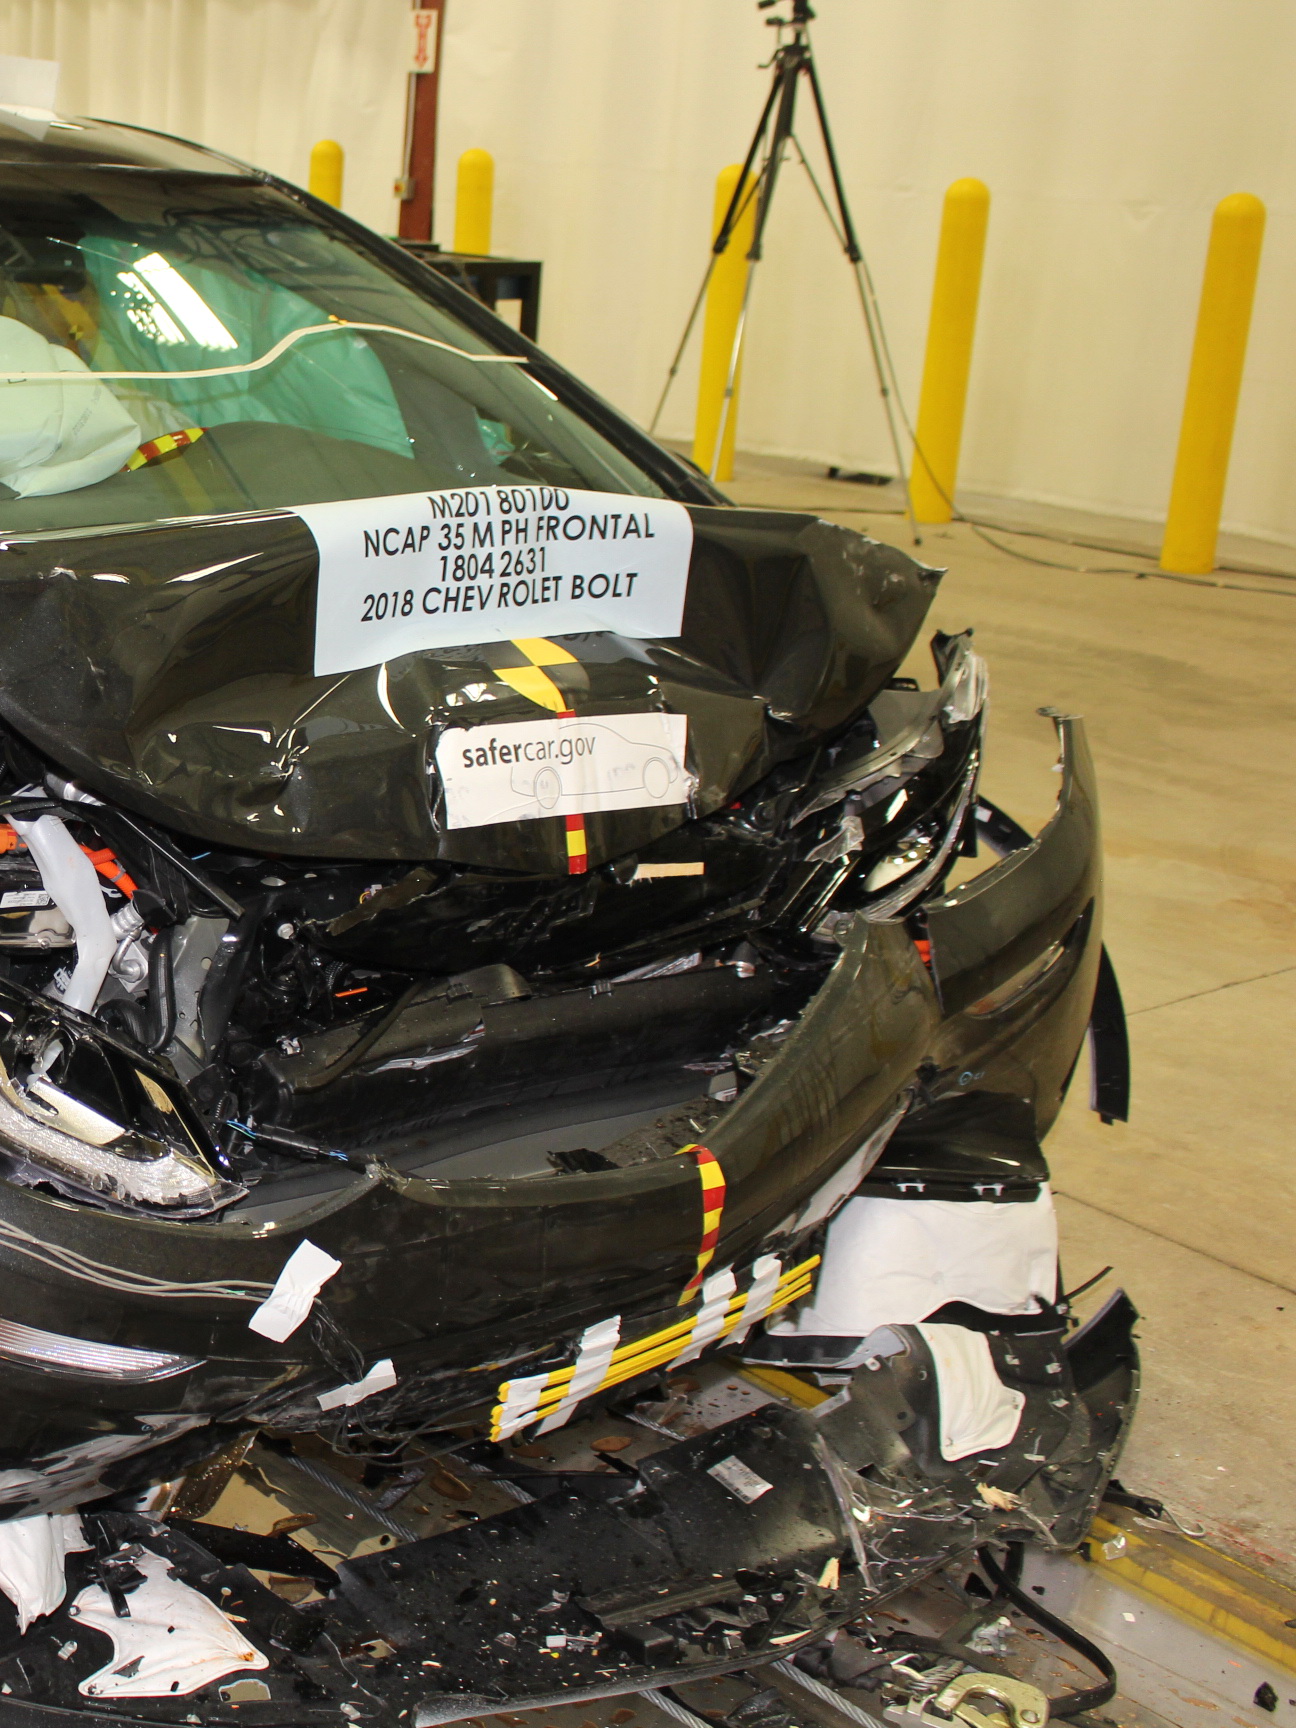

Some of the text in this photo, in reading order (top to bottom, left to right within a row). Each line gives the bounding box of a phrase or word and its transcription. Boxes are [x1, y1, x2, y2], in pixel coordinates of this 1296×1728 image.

[363, 513, 655, 557] NCAP 35 MPH FRONTAL
[439, 547, 547, 582] 18042631
[360, 572, 638, 622] 2018 CHEVROLET BOLT
[462, 736, 596, 768] safercar.gov
